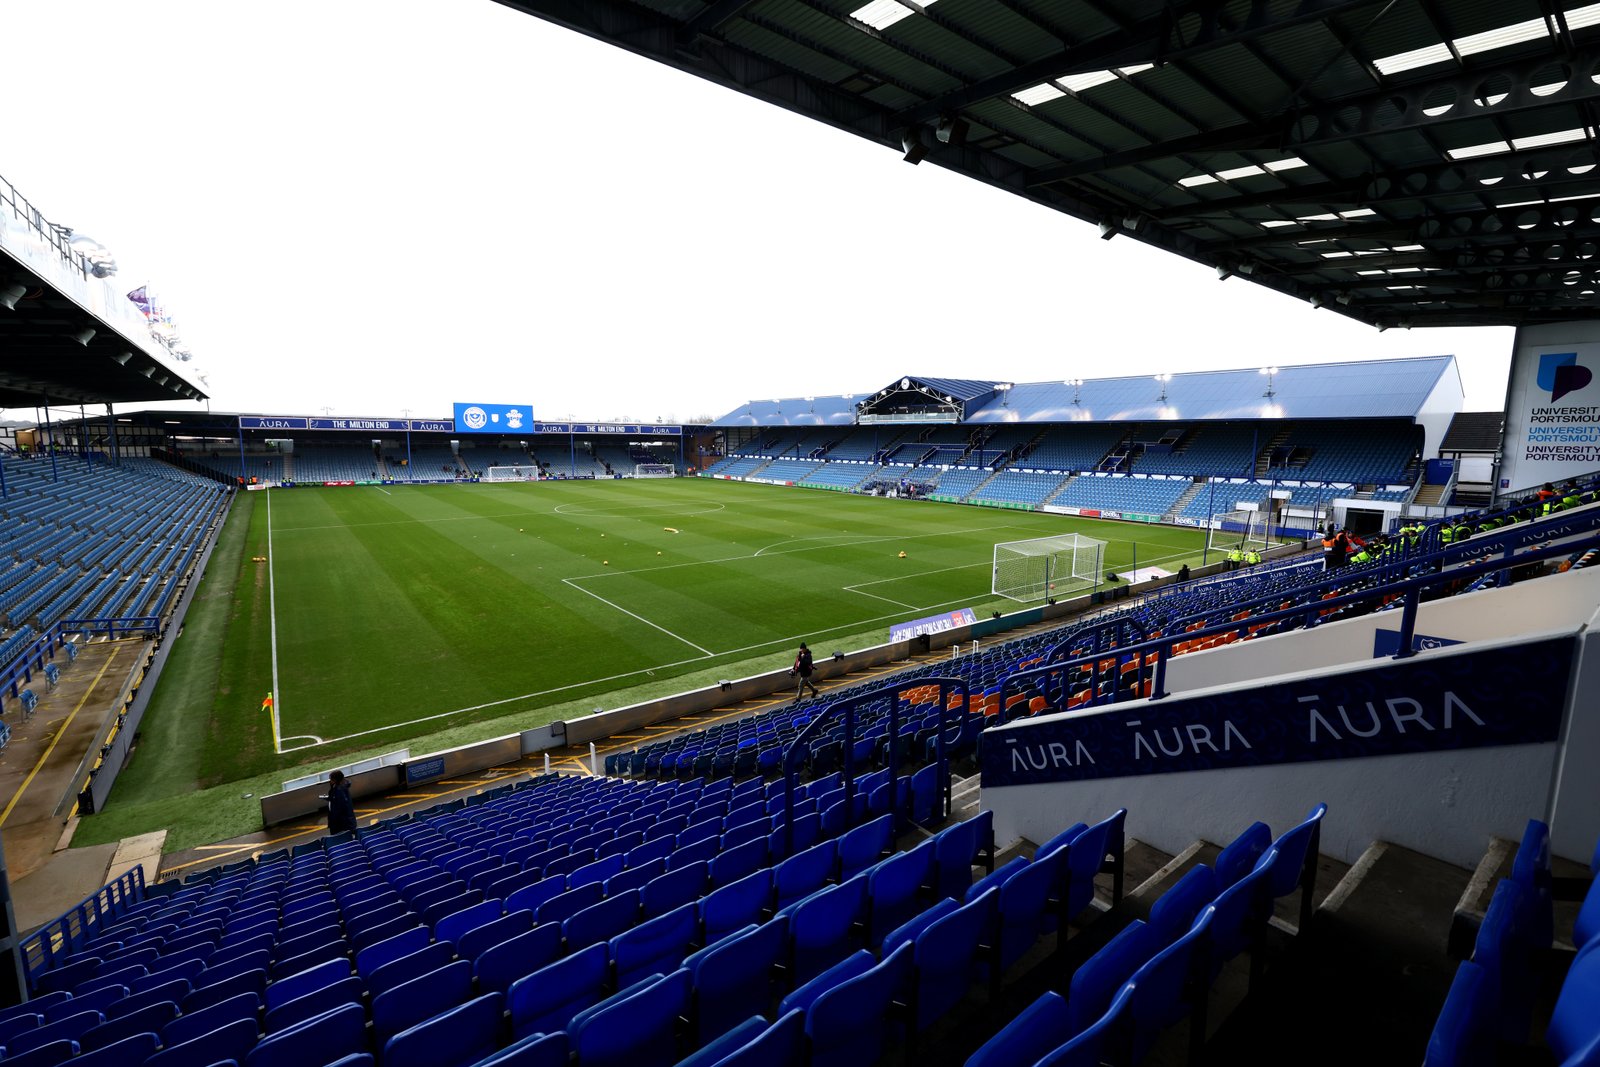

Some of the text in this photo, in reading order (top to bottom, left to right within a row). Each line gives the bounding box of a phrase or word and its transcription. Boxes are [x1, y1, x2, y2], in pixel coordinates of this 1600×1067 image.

[1531, 407, 1600, 415] UNIVERSIT
[332, 420, 390, 429] THE MILTON END
